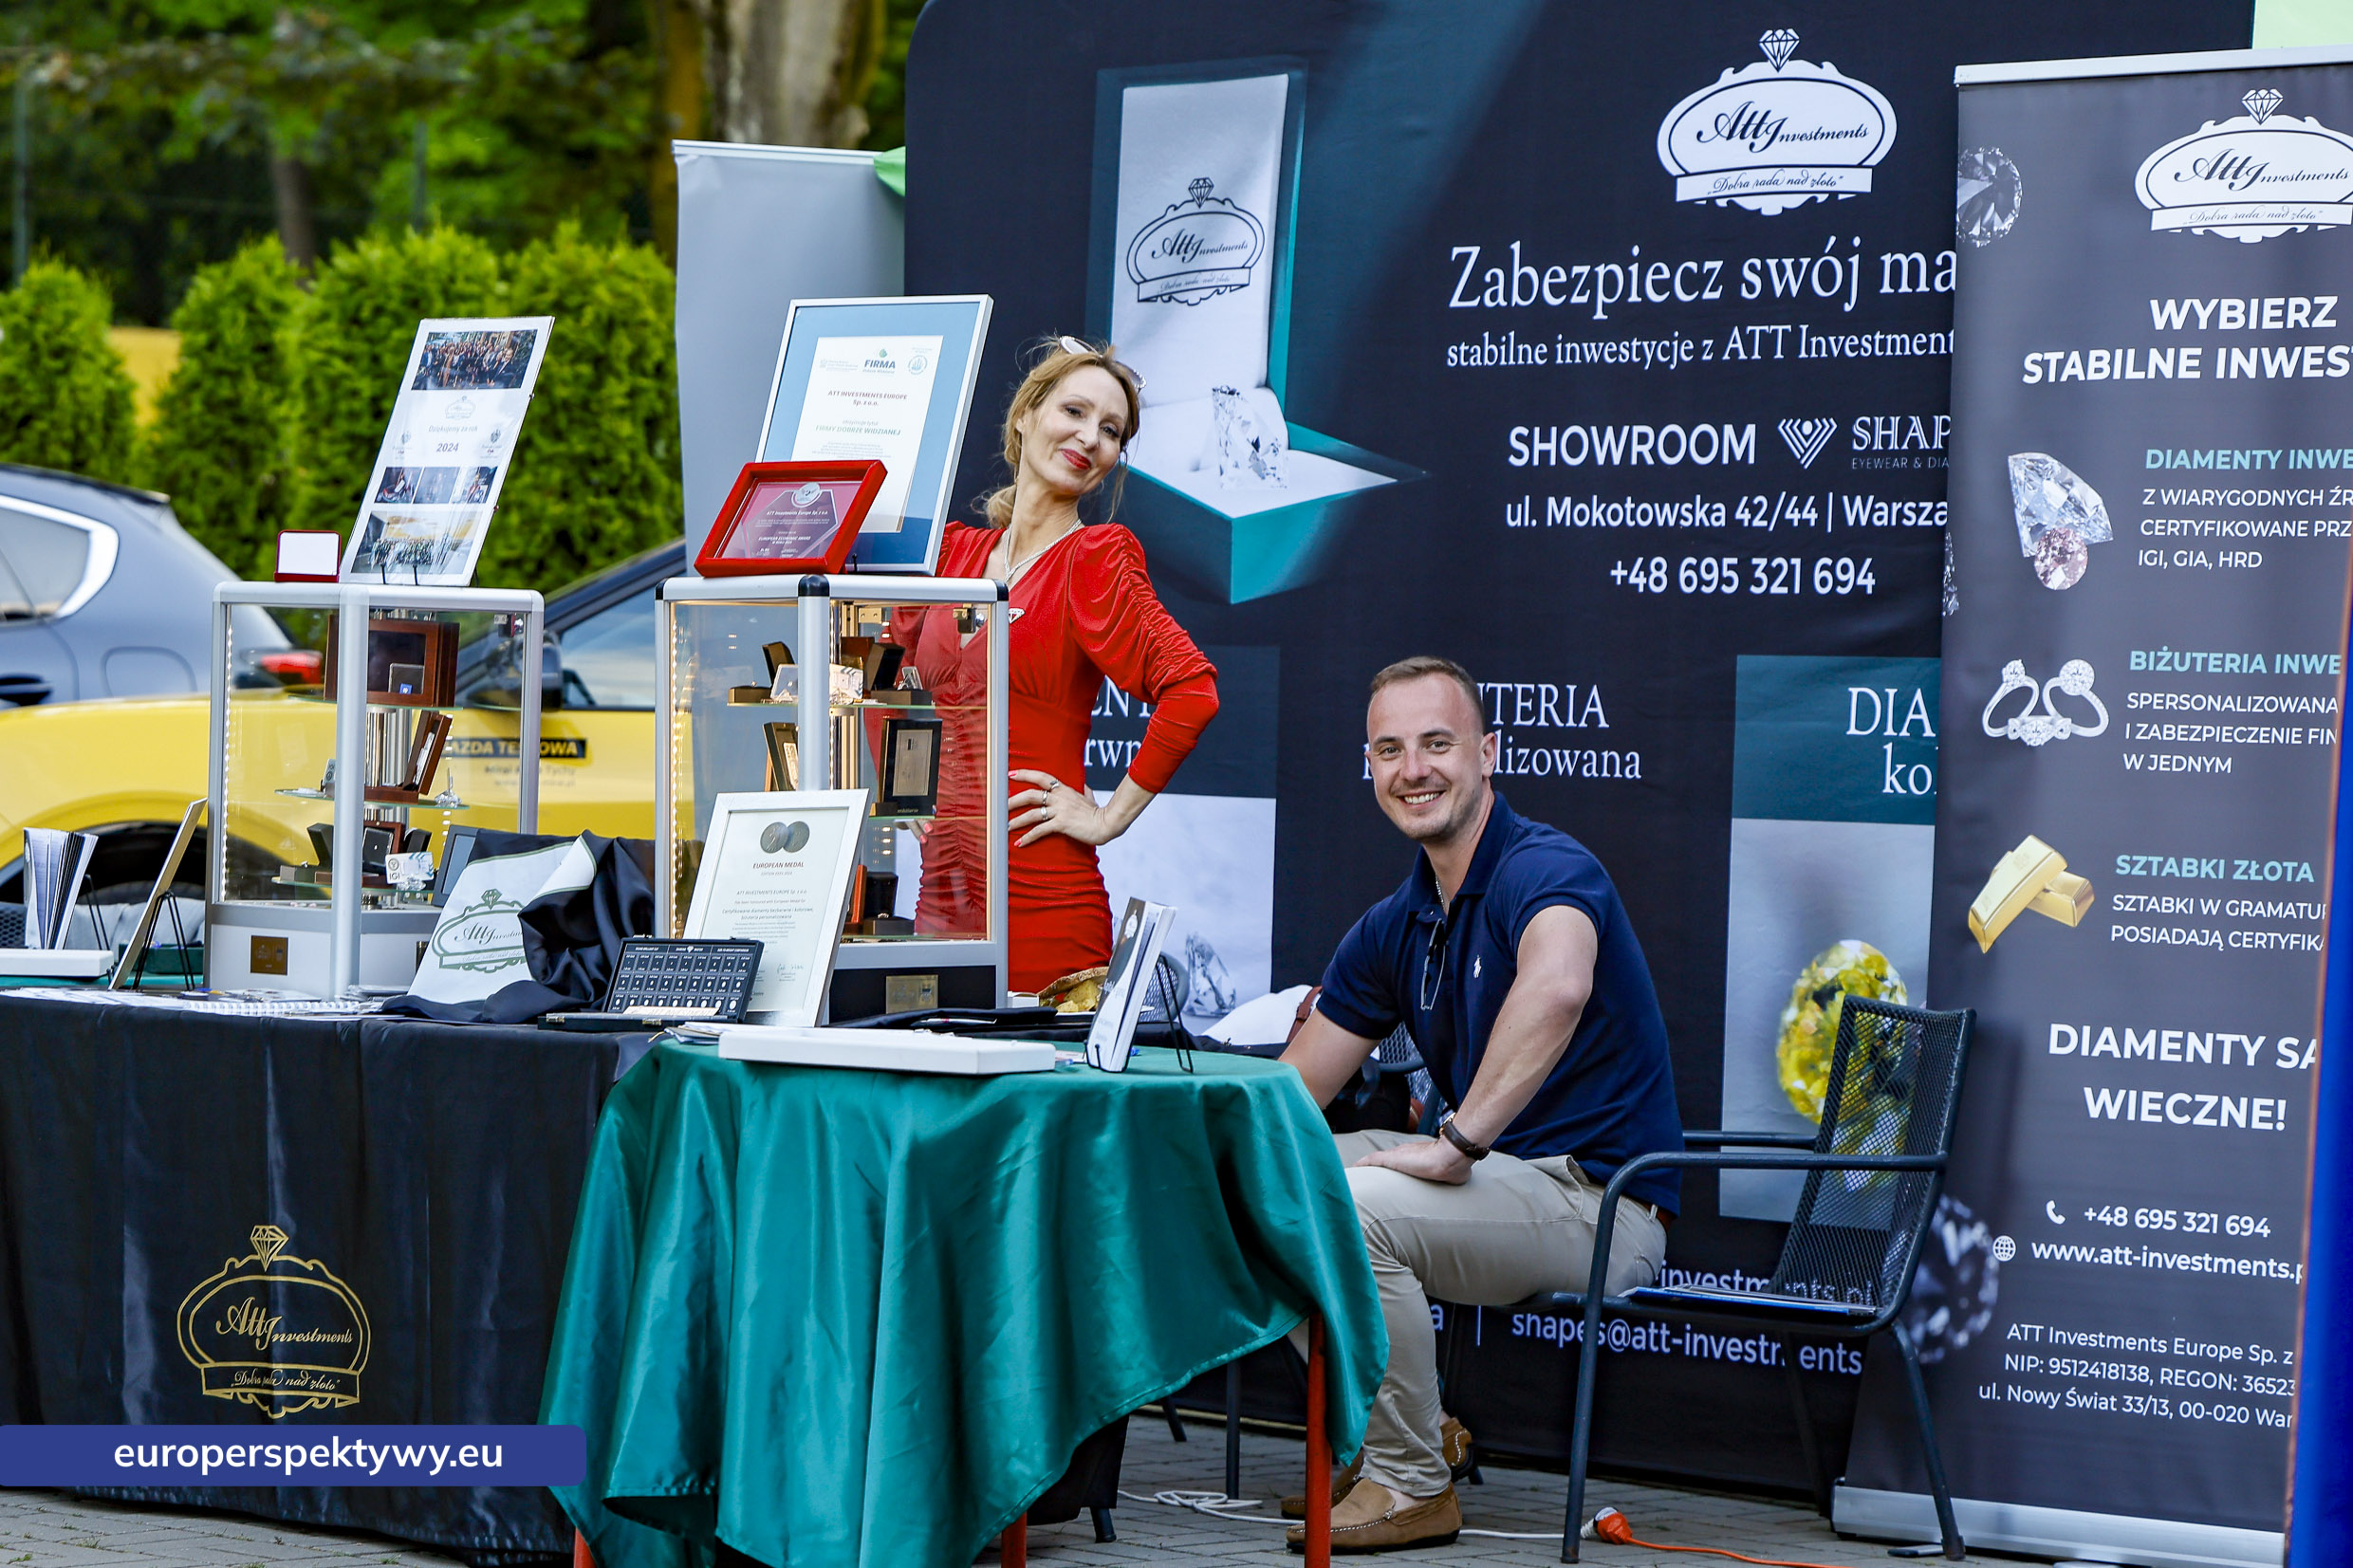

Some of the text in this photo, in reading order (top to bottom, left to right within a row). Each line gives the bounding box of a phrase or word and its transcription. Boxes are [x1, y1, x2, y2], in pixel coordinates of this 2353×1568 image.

[1448, 241, 1724, 321] Zabezpiecz
[1741, 235, 1862, 312] swój
[2149, 295, 2338, 330] WYBIERZ
[1446, 331, 1548, 368] stabilne
[1555, 330, 1695, 370] inwestycje
[1701, 338, 1714, 361] z
[1723, 324, 1792, 361] ATT
[864, 360, 897, 369] FIRMA
[2022, 344, 2353, 384] STABILNE INWES
[435, 442, 459, 452] 2024
[1508, 423, 1757, 467] SHOWROOM
[2145, 448, 2284, 470] DIAMENTY
[1852, 456, 1908, 470] EYEWEAR
[1913, 457, 1922, 469] &
[1507, 495, 1537, 527] ul.
[1547, 493, 1727, 527] Mokotowska
[1734, 491, 1819, 532] 42/44
[2142, 489, 2157, 506] Z
[2160, 489, 2325, 507] WIARYGODNYCH
[2140, 519, 2353, 538] CERTYFIKOWANE PRZ
[2139, 549, 2263, 570] IGI, GIA, HRD
[1610, 557, 1876, 595] +48 695 321 694
[2129, 645, 2268, 674] BIŻUTERIA
[2126, 692, 2339, 714] SPERSONALIZOWANA
[2135, 724, 2303, 745] ZABEZPIECZENIE
[2122, 753, 2233, 774] W JEDNYM
[2115, 854, 2315, 883] SZTABKI ZŁOTA
[2112, 894, 2195, 915] SZTABKI
[2199, 898, 2223, 916] W
[2110, 925, 2225, 952] POSIADAJĄ
[2048, 1023, 2267, 1067] DIAMENTY
[2083, 1085, 2288, 1132] WIECZNE!
[2084, 1204, 2271, 1238] +48 695 321 694
[2007, 1322, 2294, 1367] ATT Investments Europe Sp. z
[2005, 1353, 2044, 1374] NIP:
[2048, 1356, 2154, 1387] 9512418138,
[2159, 1367, 2237, 1392] REGON:
[1978, 1382, 2001, 1400] ul.
[2007, 1384, 2062, 1410] Nowy
[2065, 1386, 2118, 1411] Świat
[2121, 1393, 2174, 1420] 33/13,
[2178, 1400, 2251, 1424] 00-020
